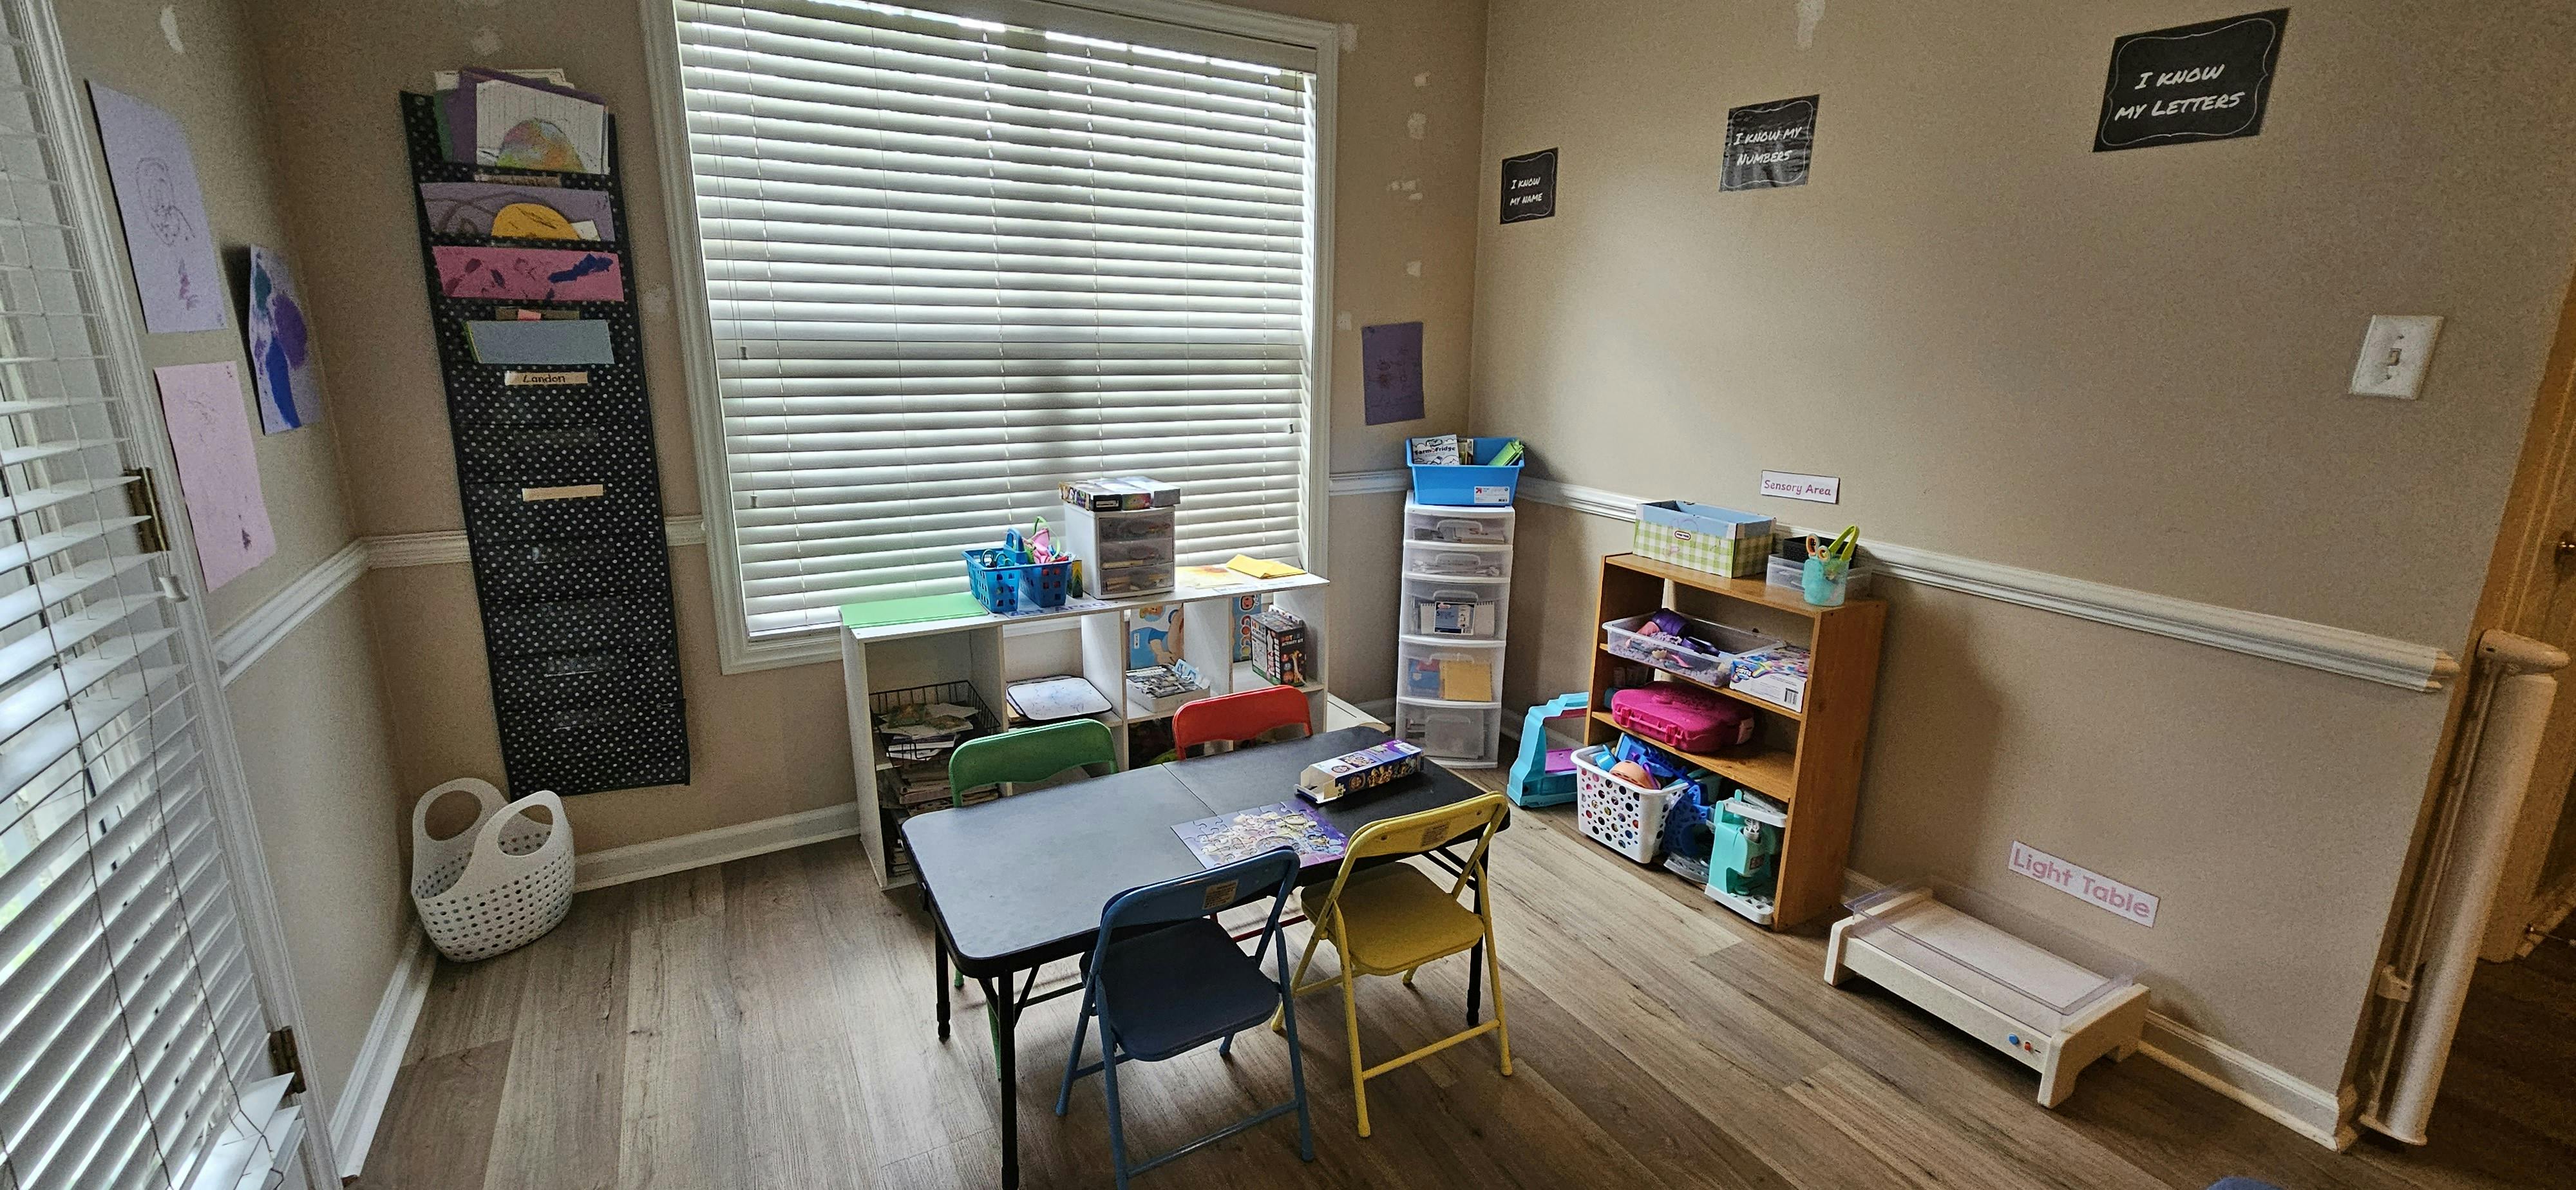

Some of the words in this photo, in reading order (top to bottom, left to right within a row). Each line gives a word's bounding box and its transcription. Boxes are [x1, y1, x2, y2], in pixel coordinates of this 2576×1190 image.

[2134, 71, 2154, 90] I
[2156, 64, 2226, 88] KNOW
[2114, 104, 2148, 121] MY
[2151, 91, 2246, 117] LETTERS
[1734, 133, 1743, 146] I
[1744, 129, 1781, 144] KNOW
[1783, 126, 1803, 140] MY
[1737, 149, 1793, 166] NUMBERS
[1511, 180, 1517, 190] I
[1518, 176, 1541, 189] KNOW
[1510, 196, 1521, 206] MY
[1522, 193, 1543, 204] NAME
[1764, 479, 1803, 496] Sensory
[1805, 484, 1832, 496] Area
[2013, 848, 2074, 887] Light
[2083, 874, 2150, 918] Table
